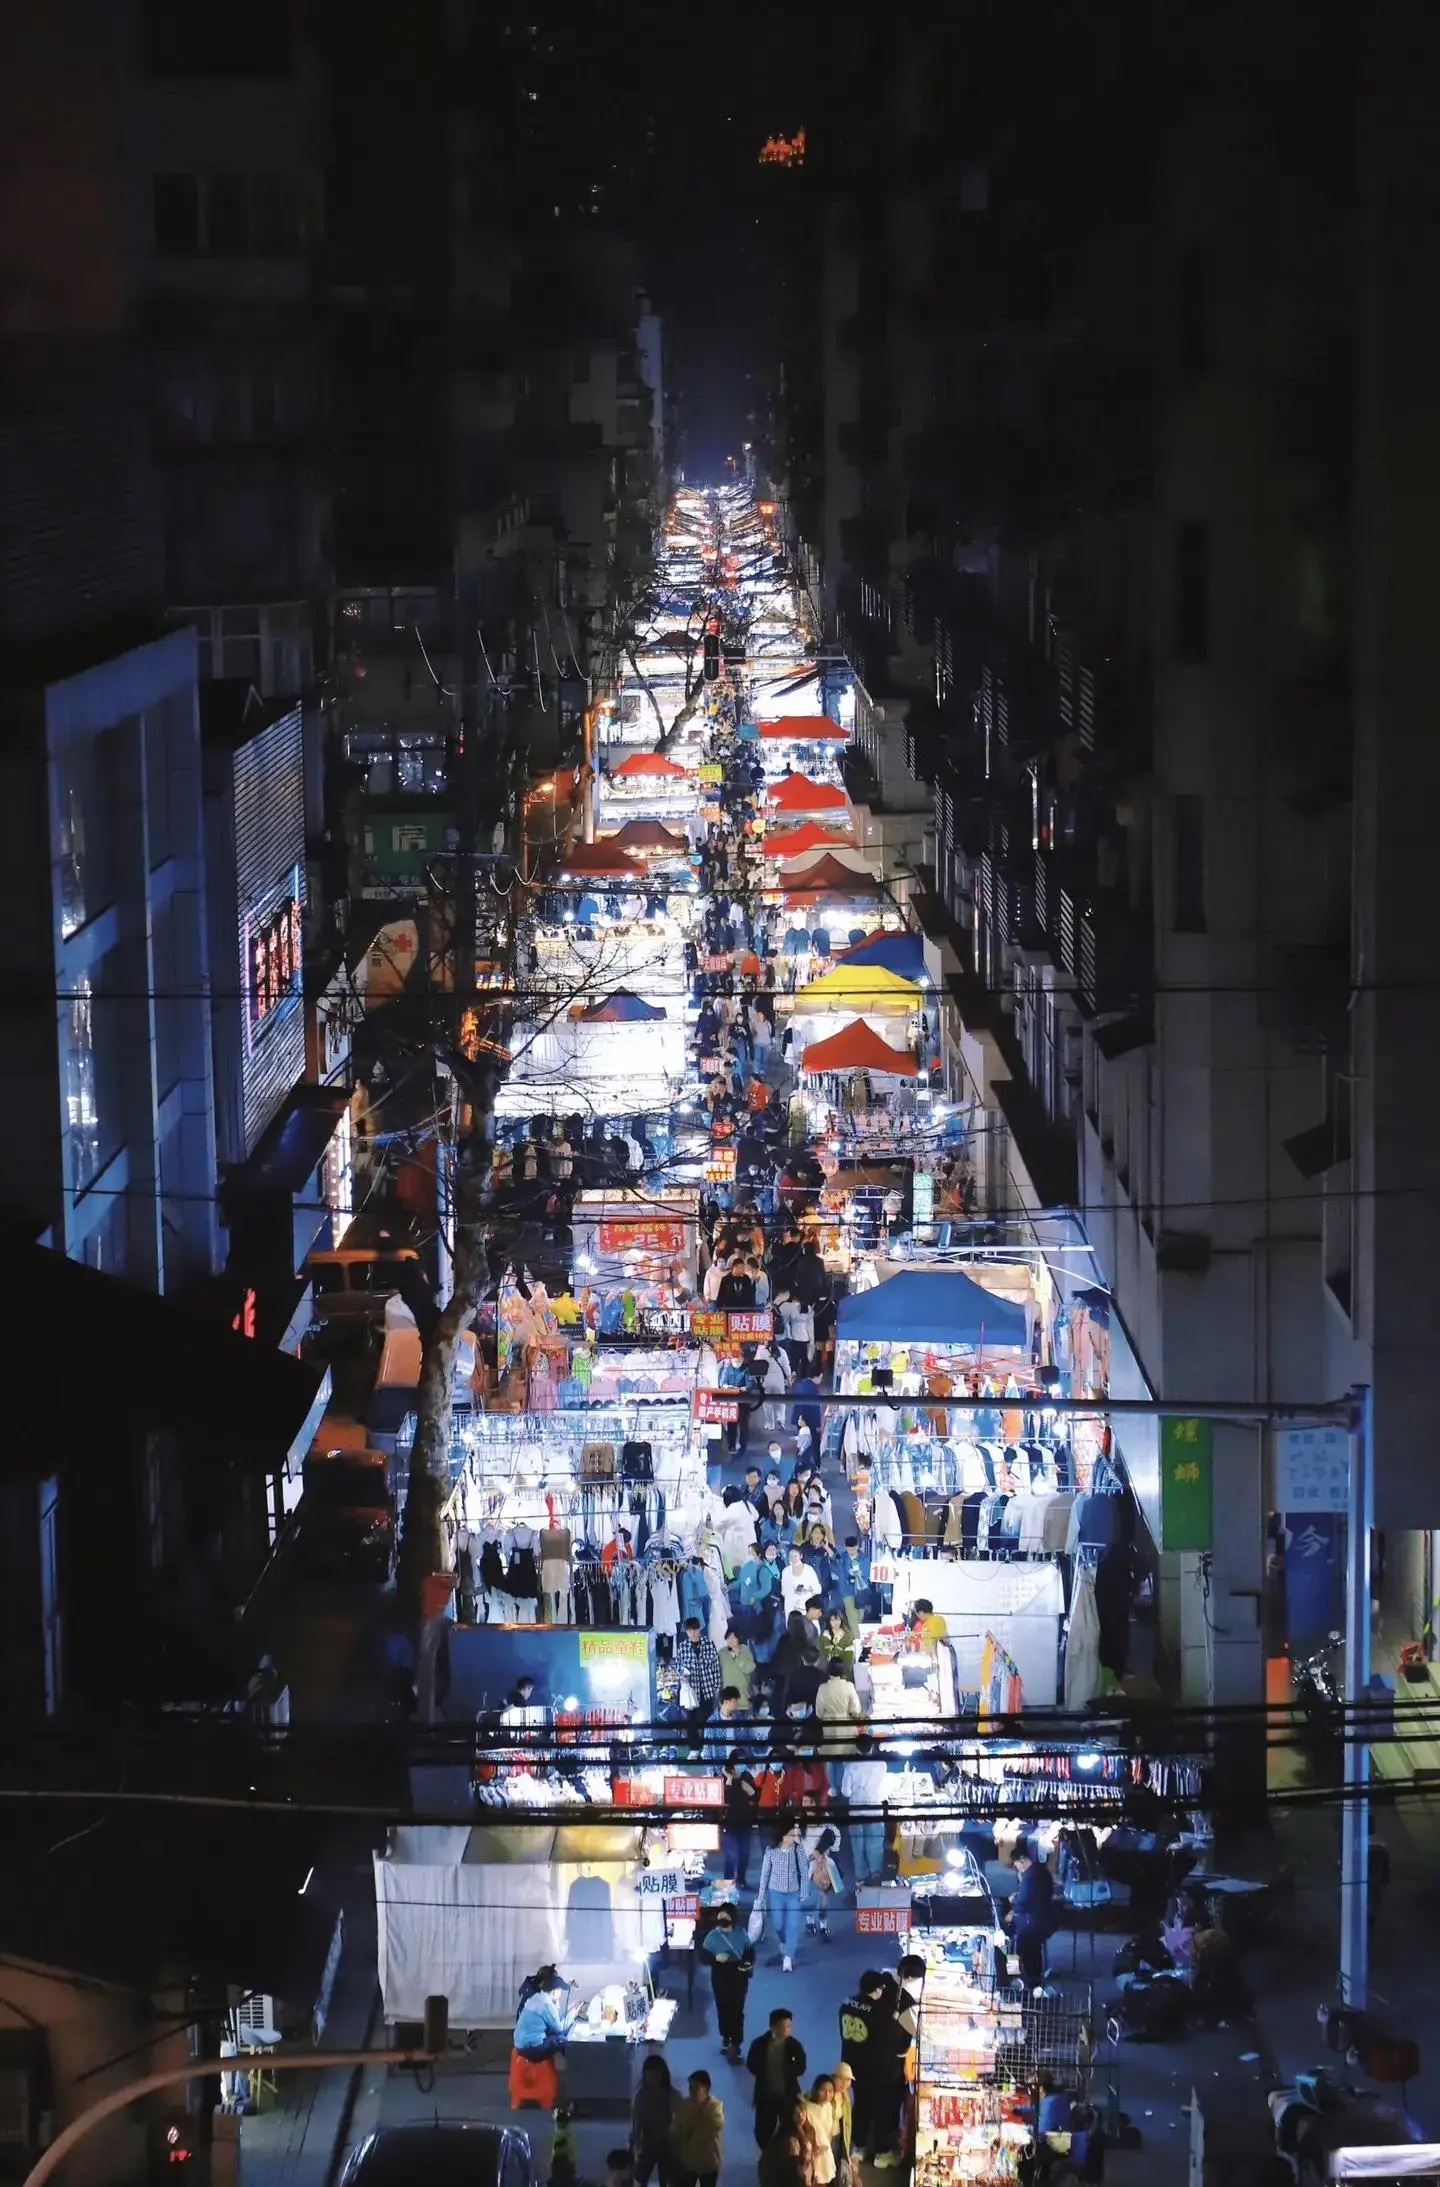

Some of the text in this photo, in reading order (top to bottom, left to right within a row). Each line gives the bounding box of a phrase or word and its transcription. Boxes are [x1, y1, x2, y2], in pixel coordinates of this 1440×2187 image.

[694, 1314, 725, 1325] 专业
[731, 1315, 771, 1333] 贴膜
[694, 1326, 723, 1336] 贴膜
[872, 1565, 889, 1582] 10
[583, 1639, 645, 1657] 精品童鞋
[642, 1872, 679, 1894] 贴膜
[858, 1911, 908, 1932] 专业贴膜
